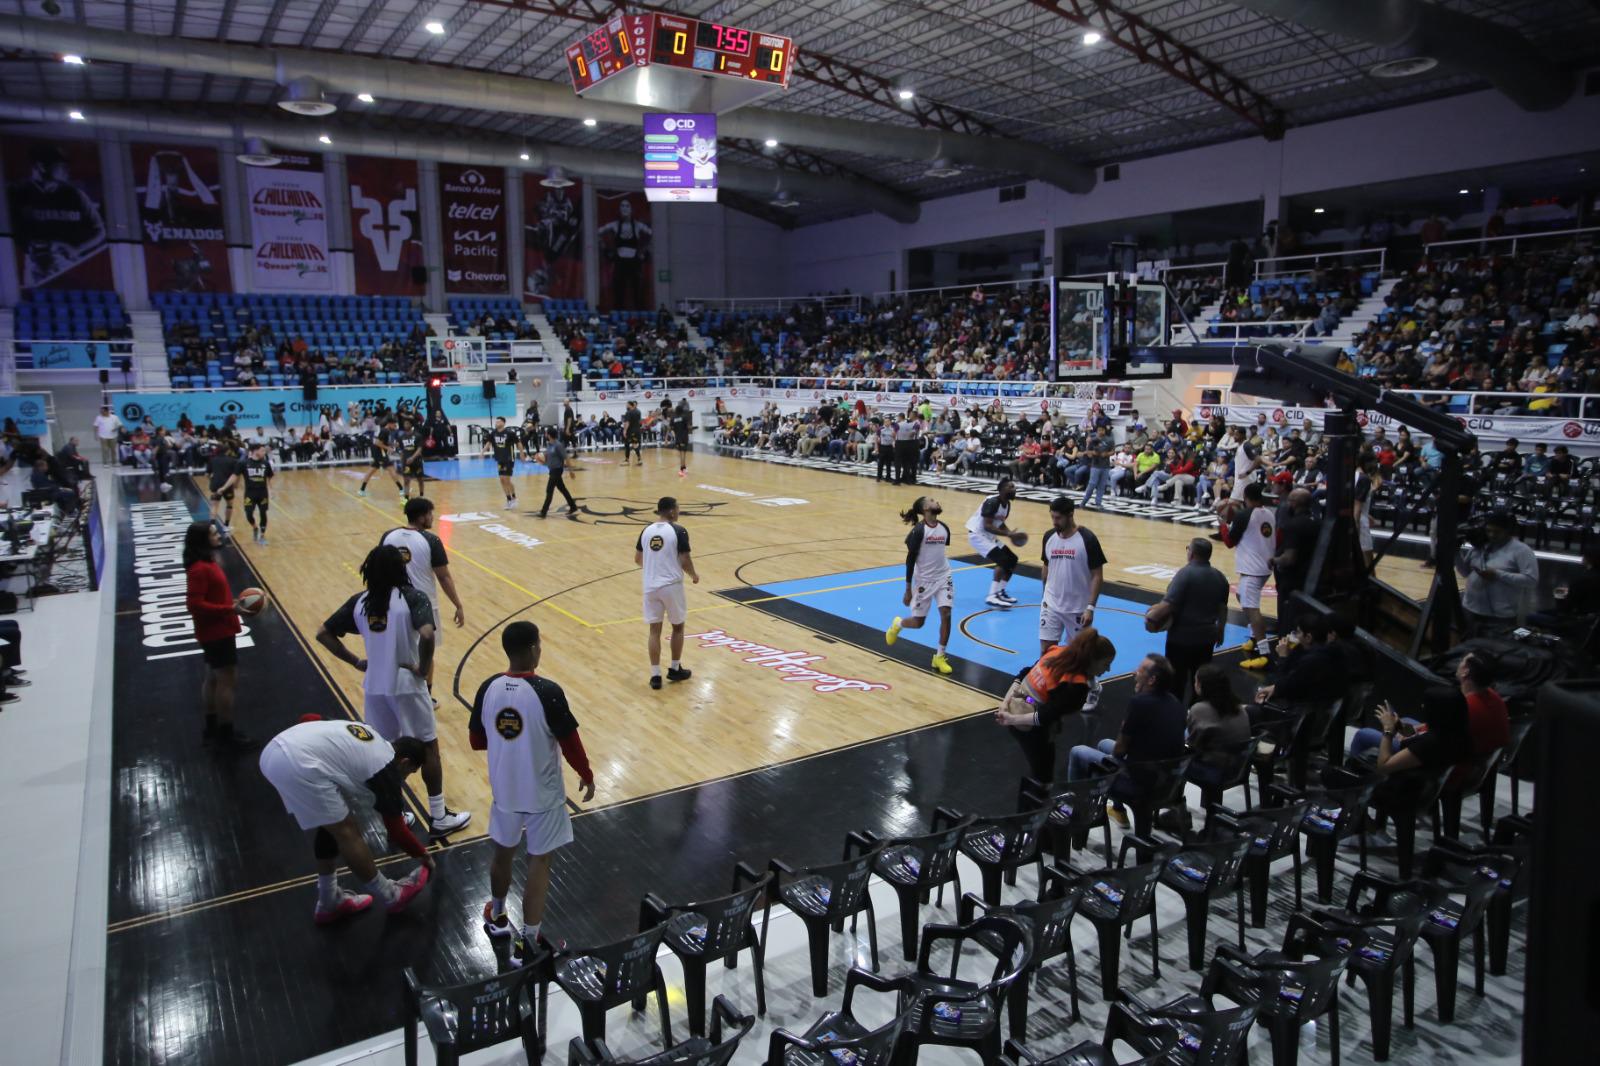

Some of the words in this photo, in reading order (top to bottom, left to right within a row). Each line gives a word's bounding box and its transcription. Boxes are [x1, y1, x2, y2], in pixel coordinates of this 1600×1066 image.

[618, 31, 629, 54] 0
[634, 16, 646, 66] LOBOS
[674, 31, 687, 55] 0
[711, 25, 748, 52] 7:55
[576, 56, 587, 77] 0
[720, 56, 726, 70] 1
[771, 50, 783, 72] 0
[677, 119, 696, 128] CID
[444, 184, 472, 193] Banco
[472, 186, 502, 195] Azteca
[253, 187, 323, 209] CHILCHOTA
[448, 202, 500, 220] telcel
[257, 241, 326, 261] CHILCHOTA
[454, 244, 498, 257] Pacific
[465, 271, 507, 282] Chevron
[1102, 403, 1116, 411] CID
[1286, 410, 1304, 420] CID
[1370, 415, 1392, 425] UAD
[1468, 419, 1494, 430] CID
